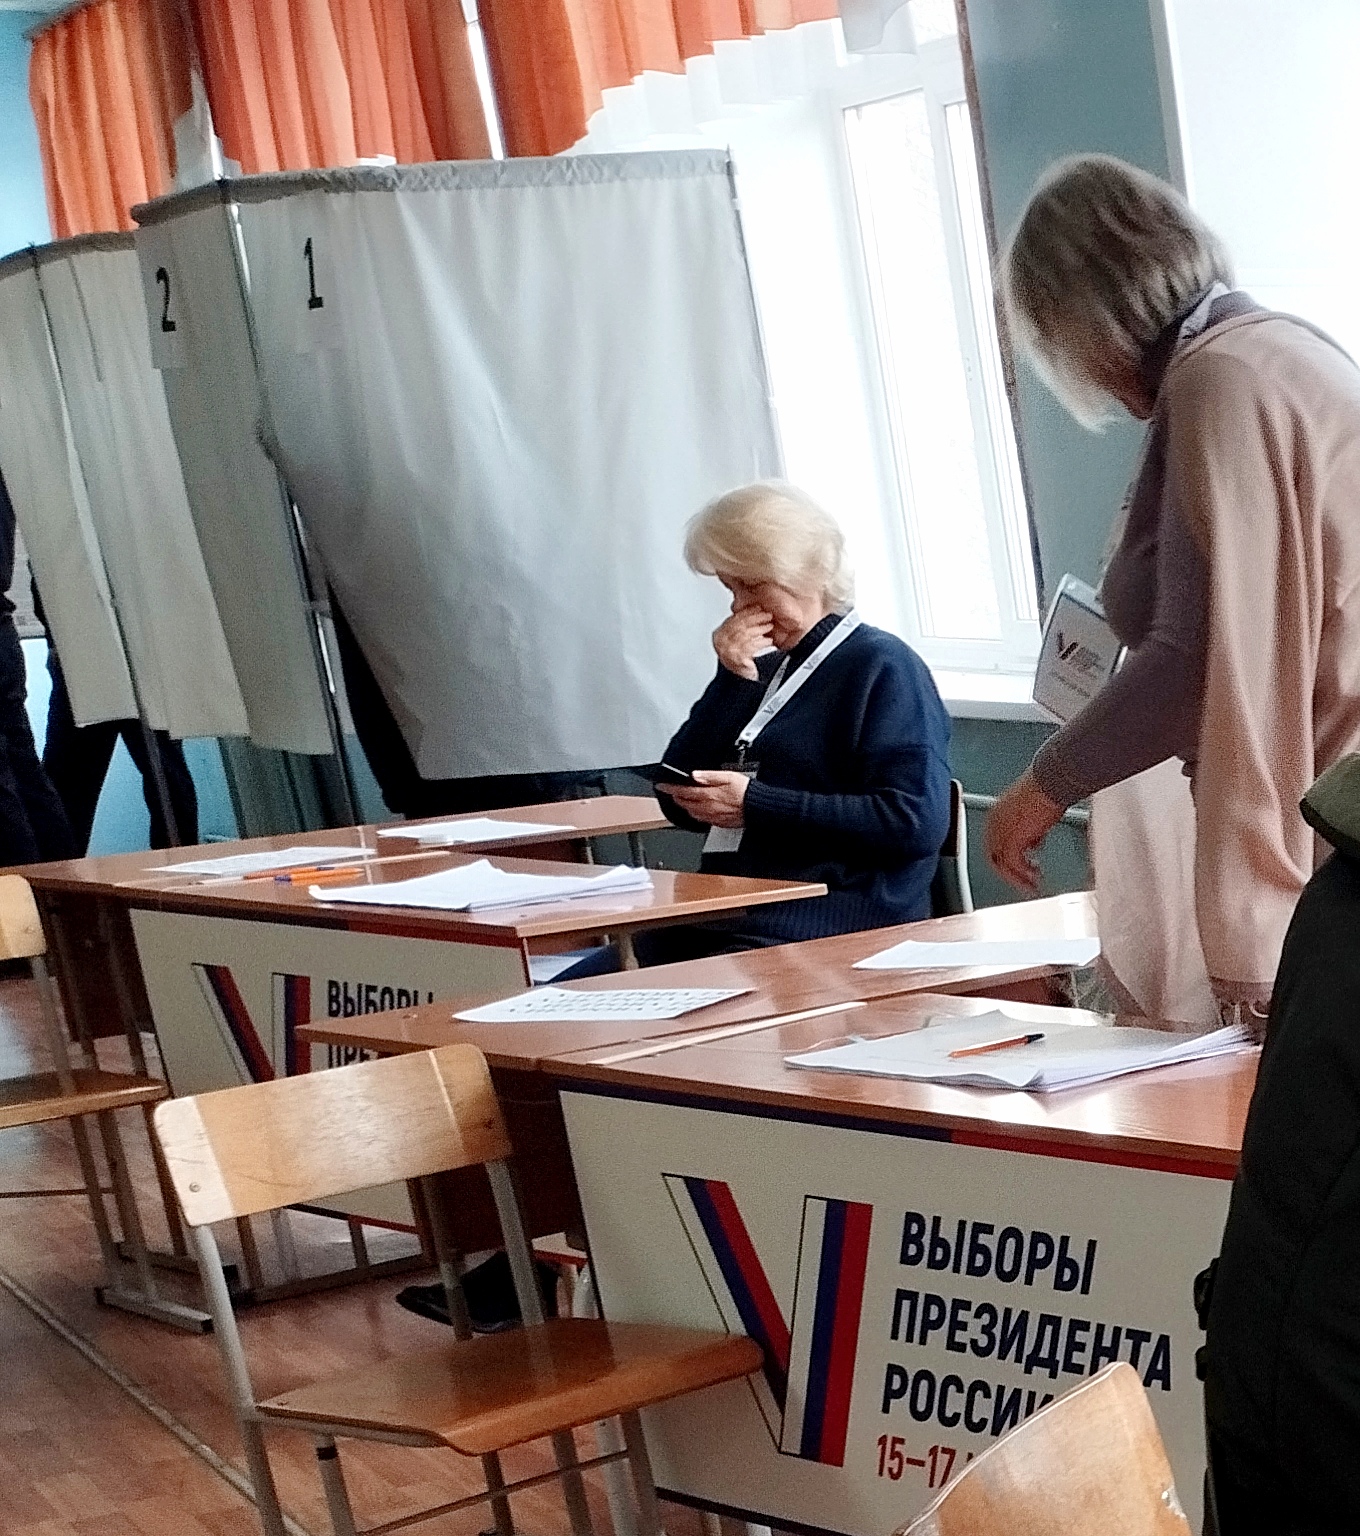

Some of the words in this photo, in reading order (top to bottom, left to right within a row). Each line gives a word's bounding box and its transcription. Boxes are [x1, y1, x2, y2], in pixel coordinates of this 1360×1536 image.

[156, 266, 177, 332] 2
[304, 237, 323, 310] 1
[900, 1211, 1098, 1295] ВЫБОРЫ
[891, 1287, 1172, 1391] ПРЕЗИДЕНТА
